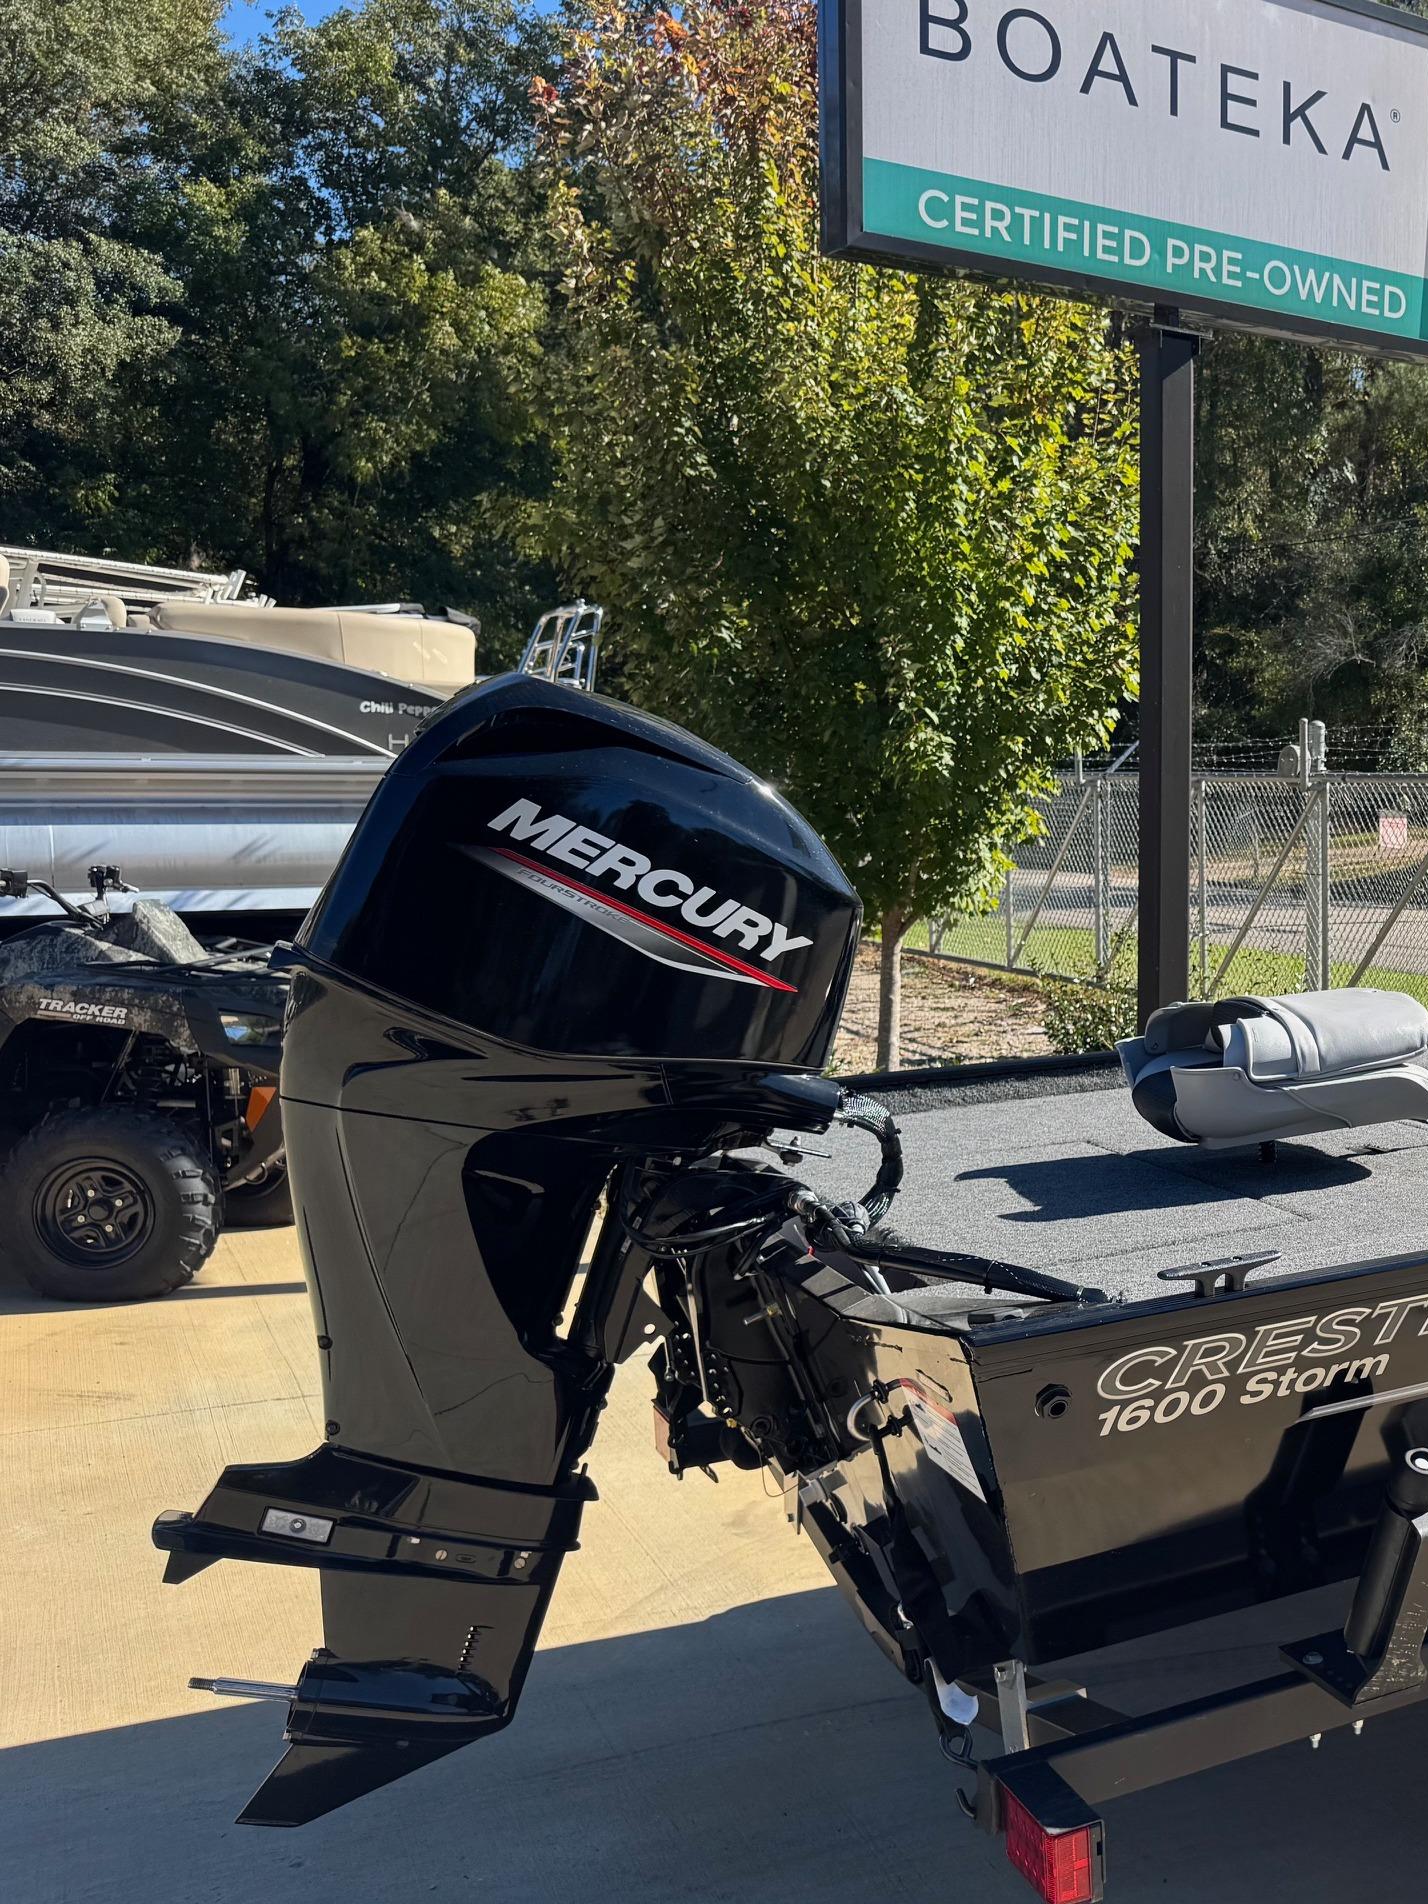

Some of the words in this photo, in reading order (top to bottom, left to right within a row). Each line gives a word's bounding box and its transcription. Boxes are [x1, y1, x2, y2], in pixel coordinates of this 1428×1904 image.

[919, 0, 1391, 172] BOATEKA
[918, 189, 1151, 268] CERTIFIED
[1166, 237, 1407, 319] PRE-OWNED
[360, 701, 394, 714] Chili
[398, 703, 437, 717] Pepp
[487, 798, 813, 961] MERCURY
[39, 998, 128, 1018] TRACKER
[96, 1017, 126, 1025] ROAD
[1098, 1383, 1226, 1437] 1600
[1240, 1351, 1390, 1406] Storm
